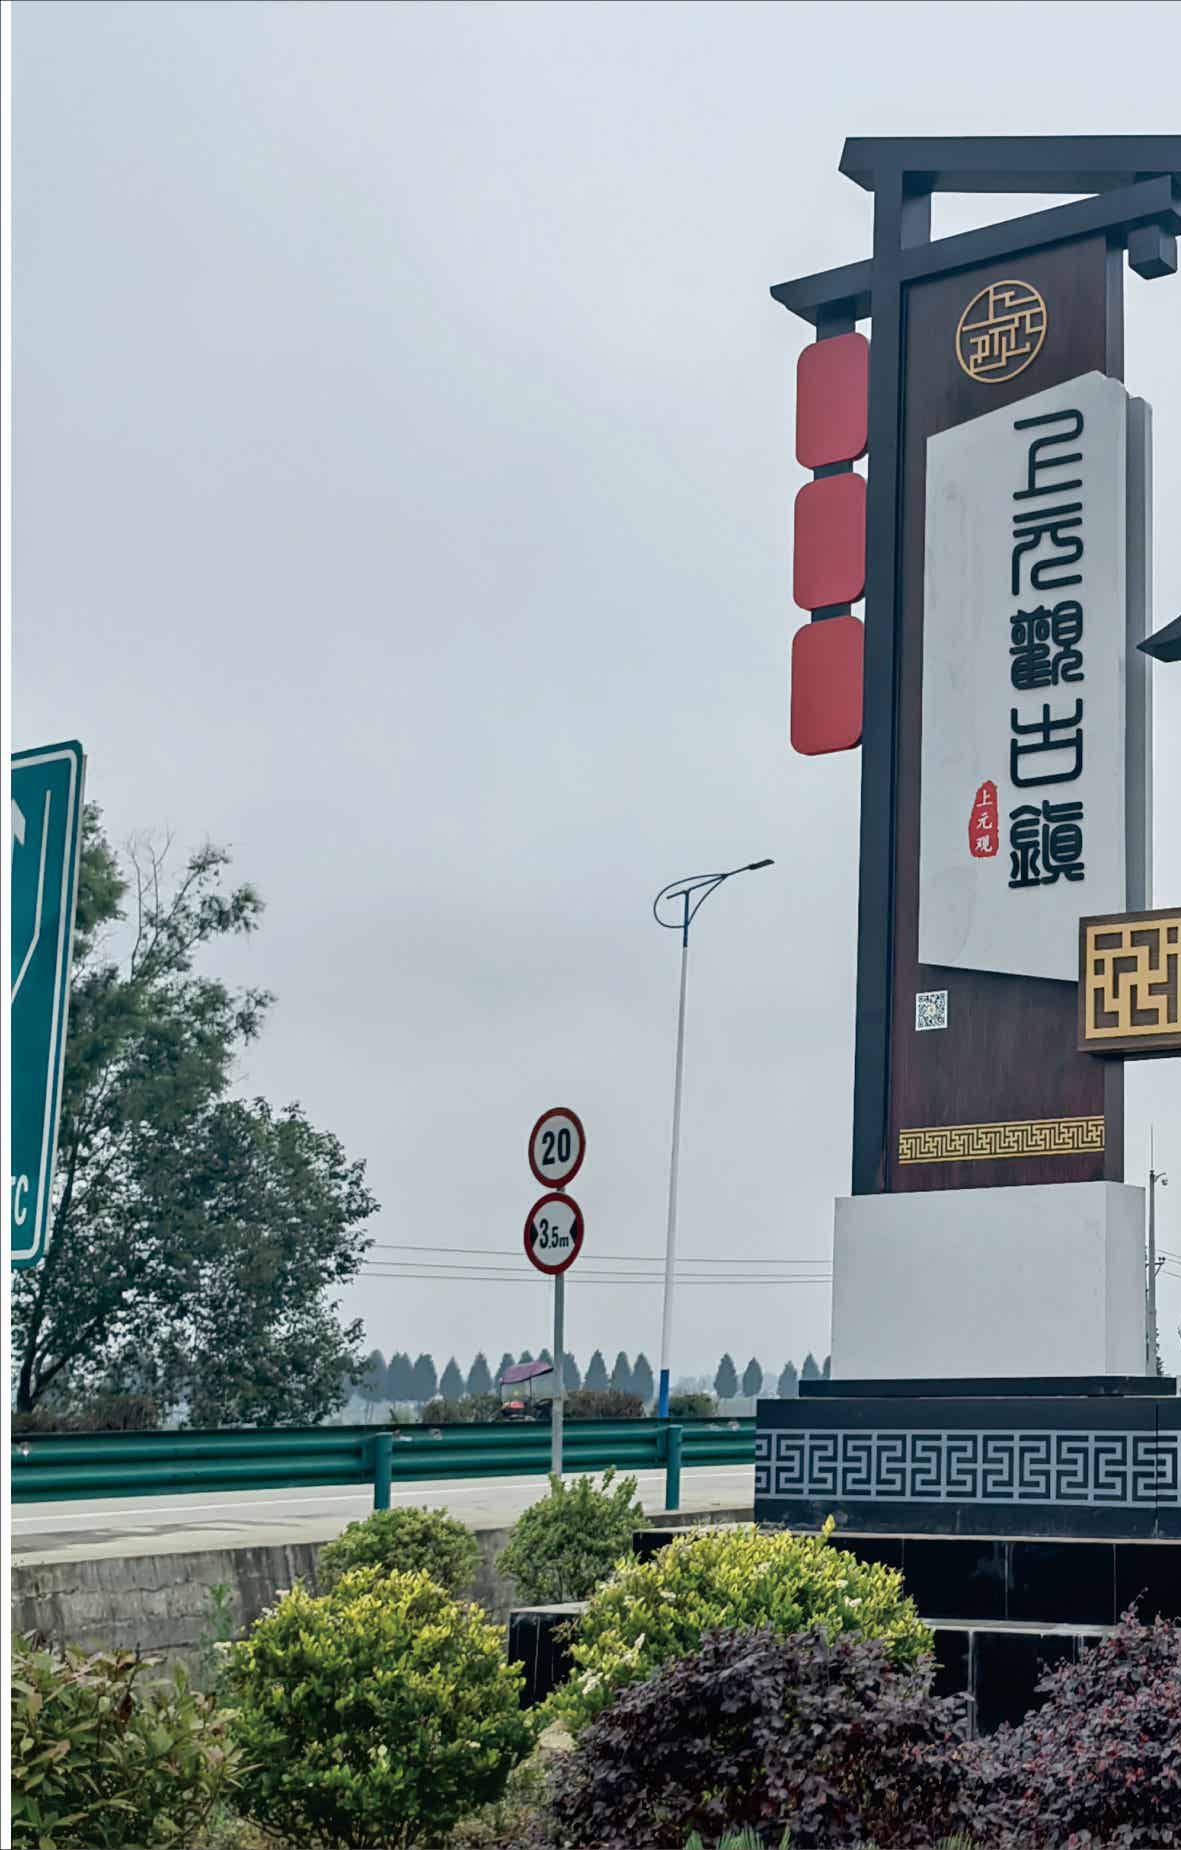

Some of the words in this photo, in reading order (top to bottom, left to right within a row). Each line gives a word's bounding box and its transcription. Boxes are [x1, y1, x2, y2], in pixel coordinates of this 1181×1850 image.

[975, 789, 993, 853] 上元观
[541, 1127, 571, 1166] 20
[539, 1218, 570, 1250] 3.5m
